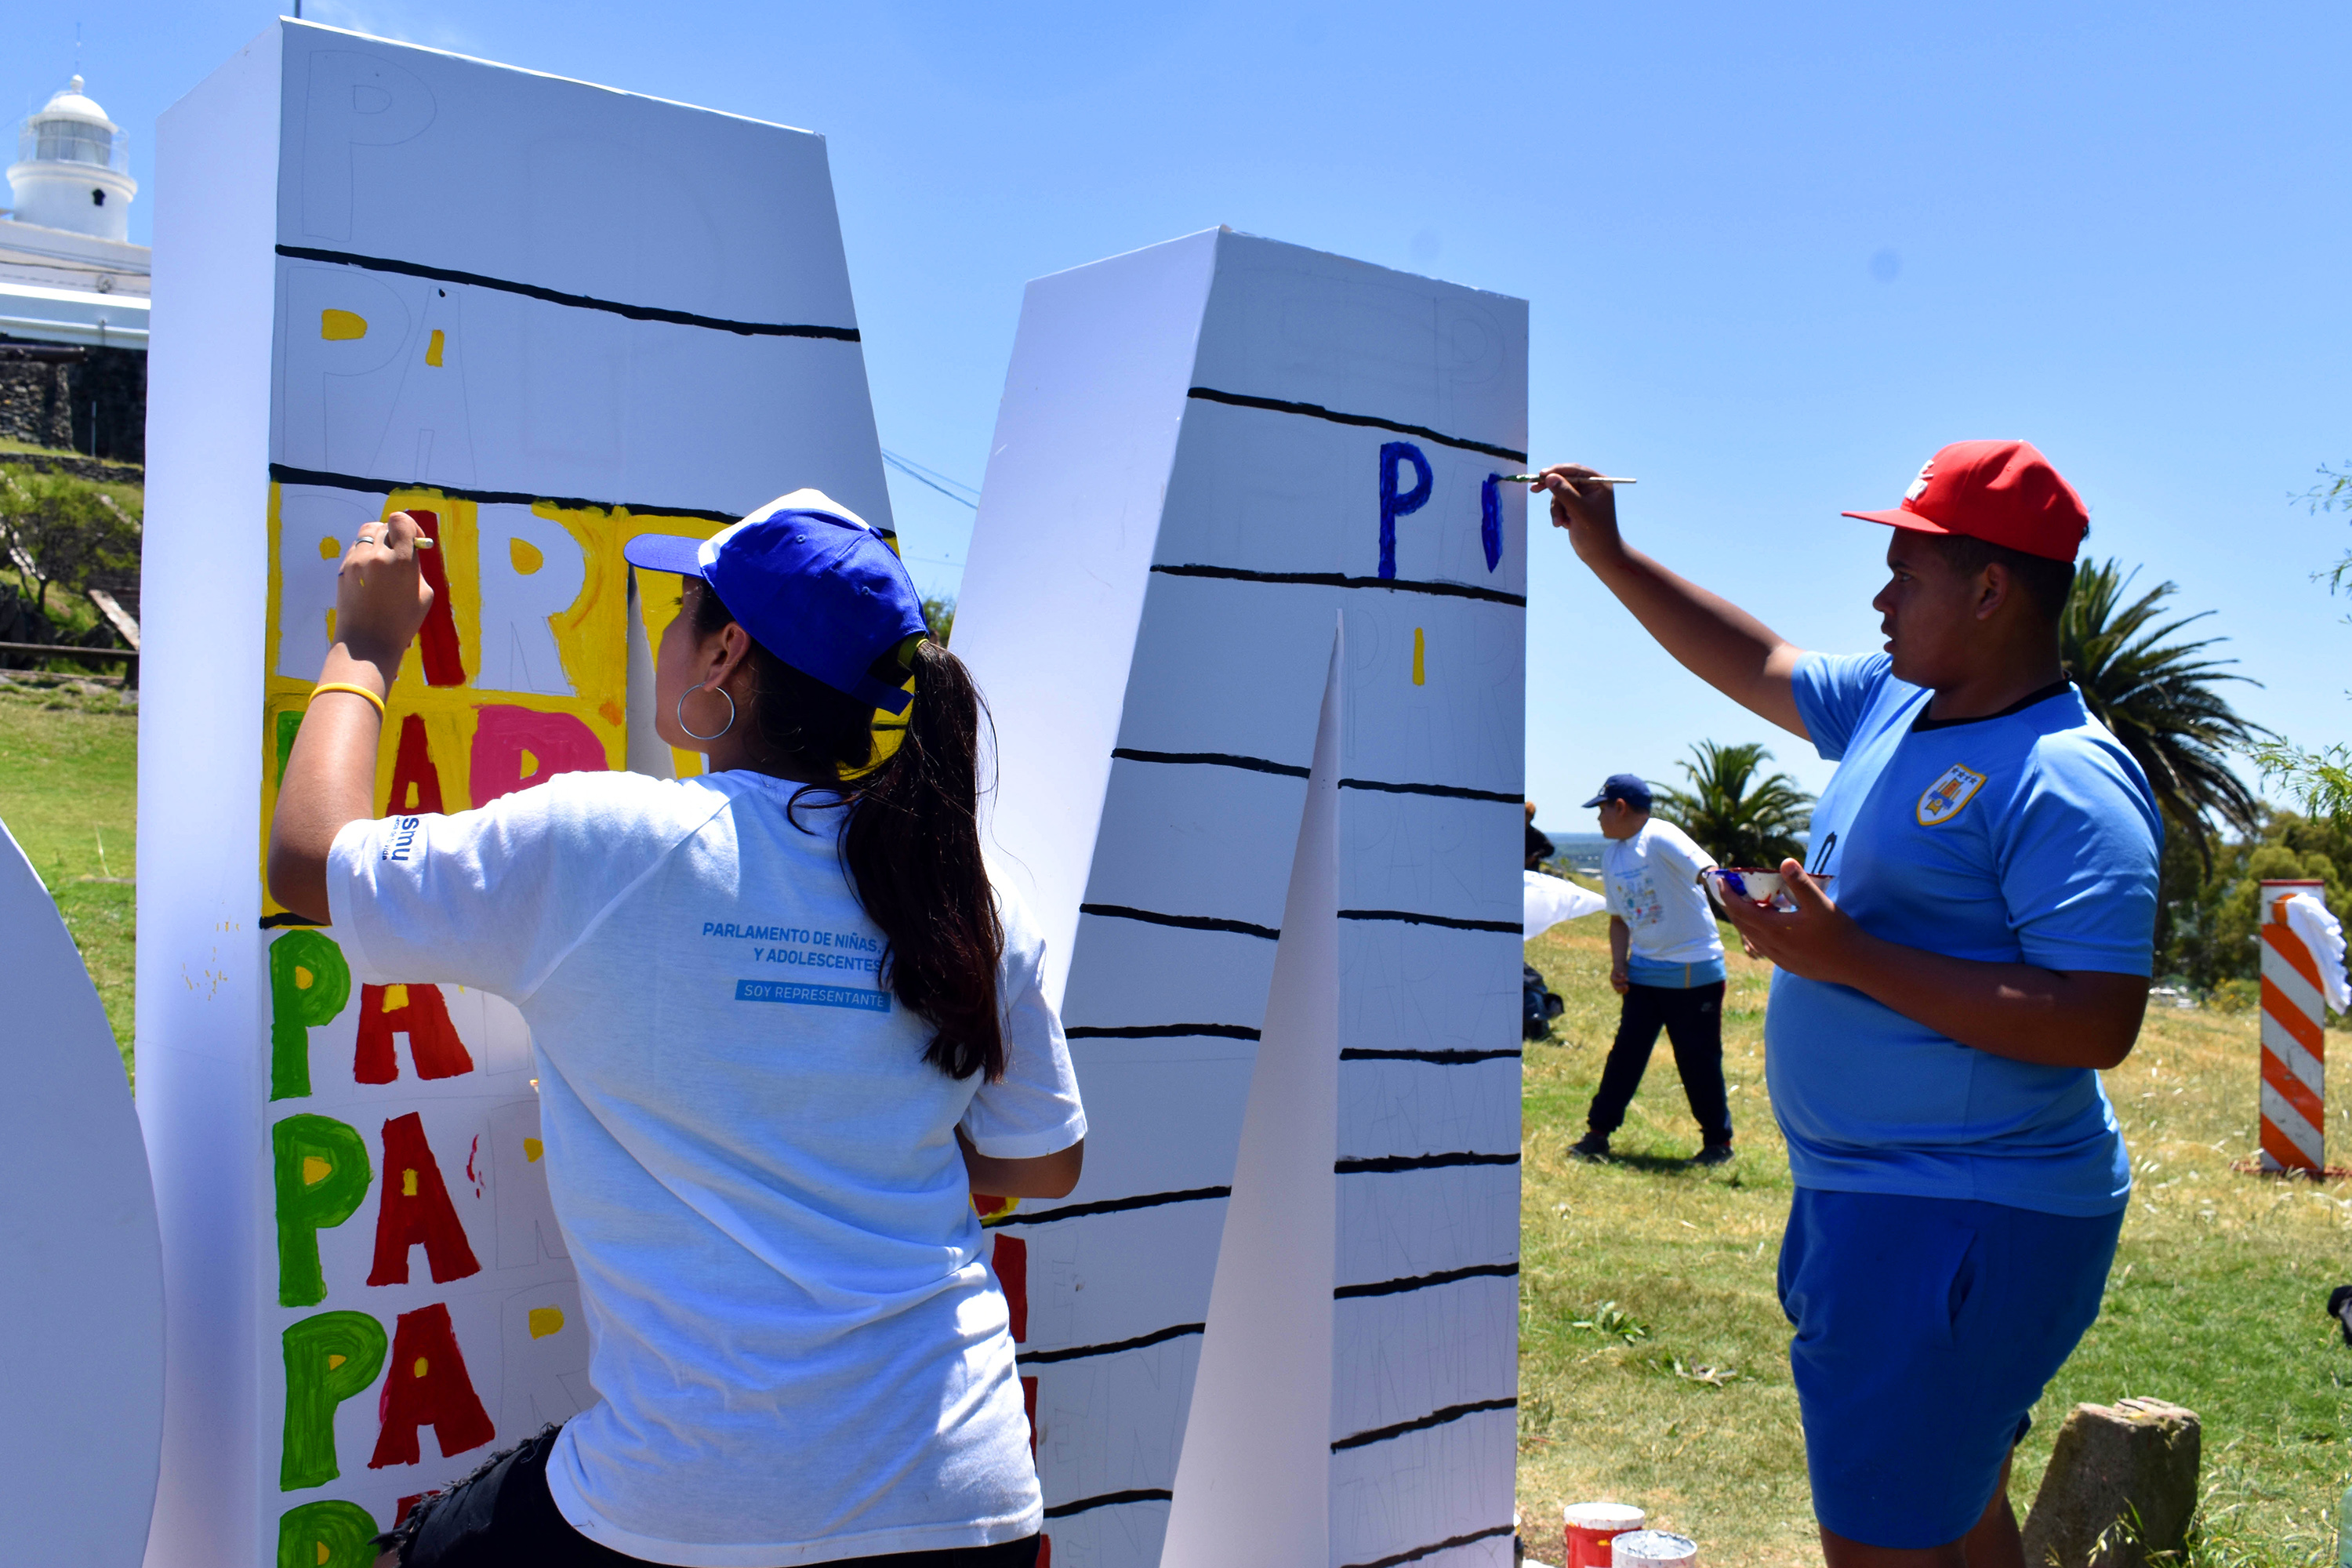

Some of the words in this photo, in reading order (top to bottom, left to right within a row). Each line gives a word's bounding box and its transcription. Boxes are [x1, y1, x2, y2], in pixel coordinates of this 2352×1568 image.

[391, 818, 419, 861] smu
[702, 922, 810, 944] PARLAMENTO
[812, 931, 832, 947] DE
[753, 947, 764, 961] Y
[766, 949, 881, 972] ADOLESCENTES
[744, 985, 772, 998] SOY
[775, 986, 884, 1007] REPRESENTANTE
